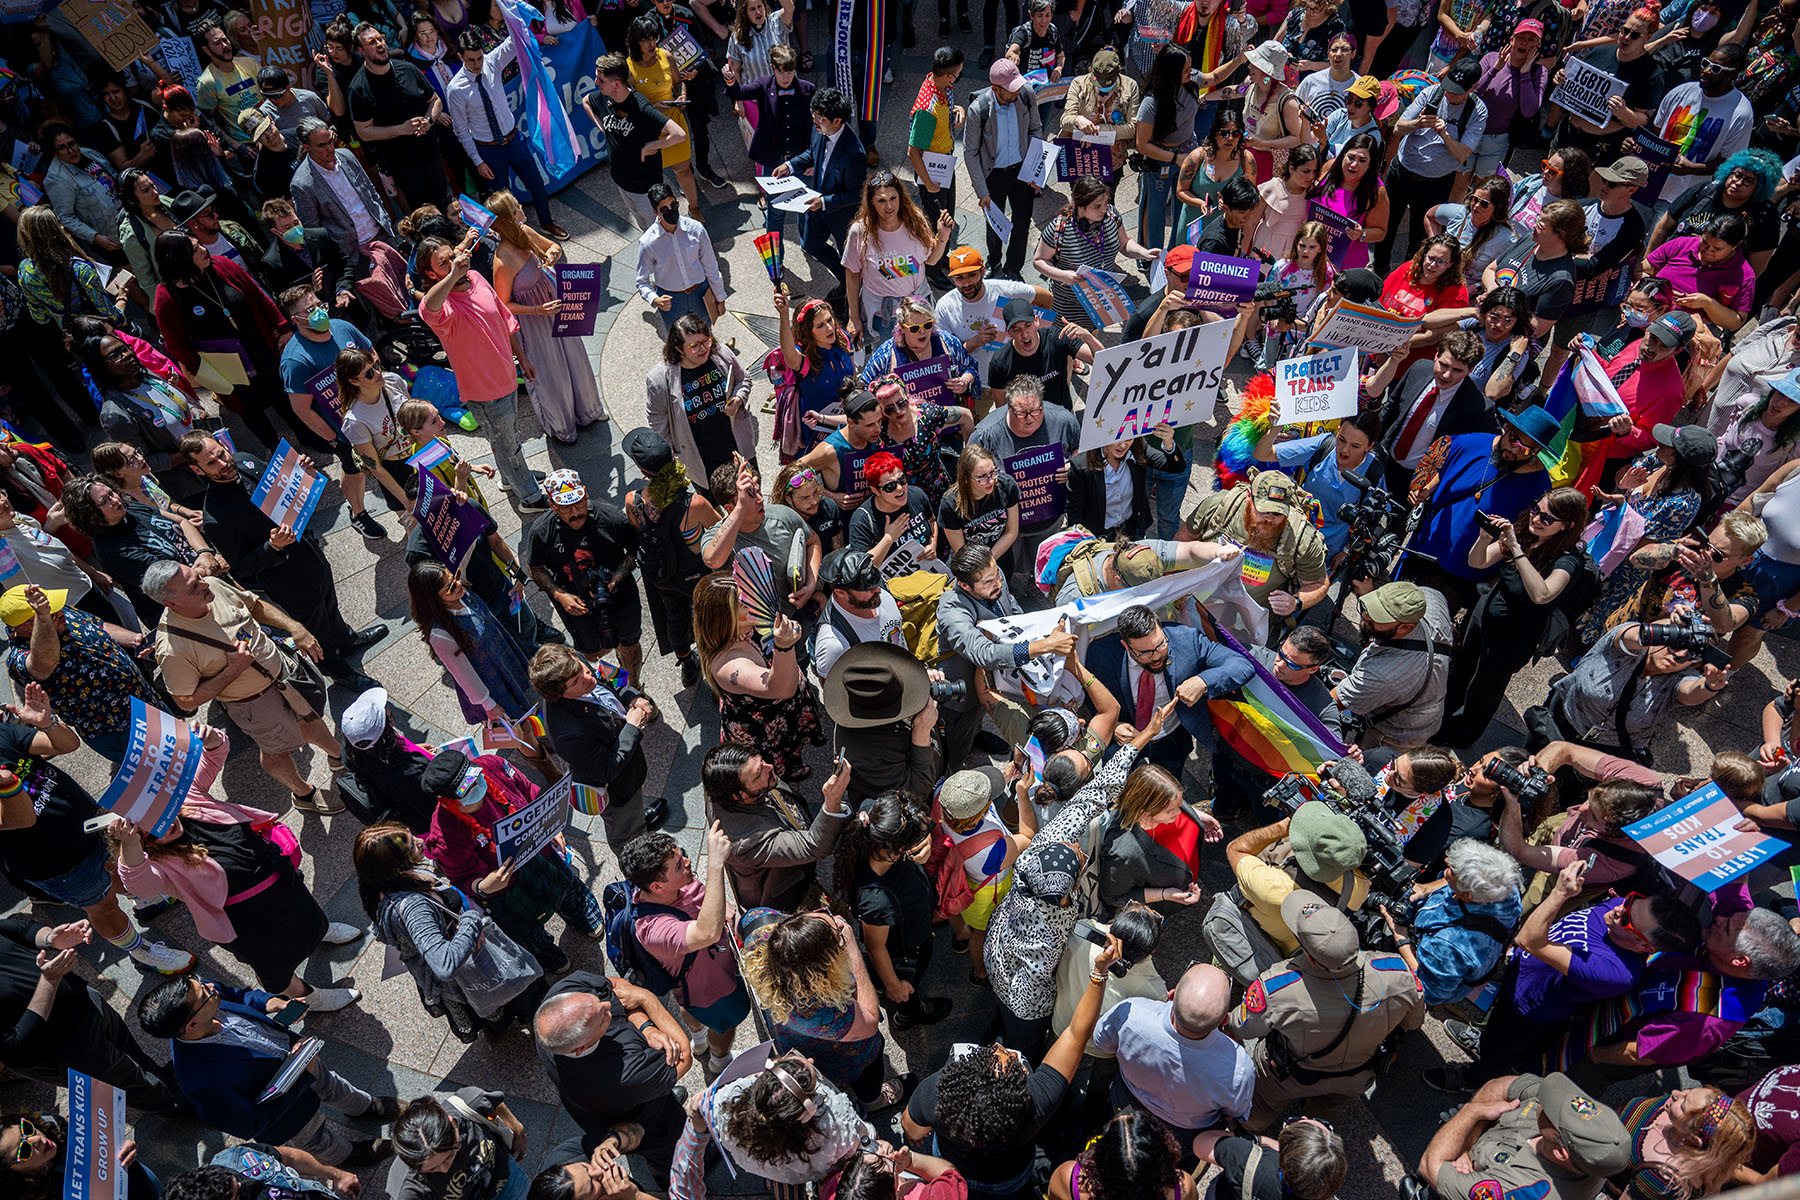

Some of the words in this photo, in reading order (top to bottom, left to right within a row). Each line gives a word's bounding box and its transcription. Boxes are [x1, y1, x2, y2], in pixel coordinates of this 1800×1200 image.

[80, 1, 131, 36] TRANS
[98, 18, 156, 66] KIDS!!
[677, 30, 687, 41] BE
[838, 1, 852, 64] REJOICE
[161, 41, 176, 60] YOU
[267, 44, 306, 66] ARE
[1574, 66, 1612, 94] LGBTQ
[602, 114, 635, 136] Unity
[1638, 134, 1672, 157] ORGANIZE
[937, 163, 948, 171] 404
[1061, 144, 1069, 177] ORGANIZE
[1069, 166, 1076, 177] TO
[1314, 212, 1324, 221] TO
[1315, 207, 1349, 226] ORGANIZE
[876, 254, 914, 270] PRIDE
[1201, 260, 1250, 279] ORGANIZE
[561, 270, 595, 279] ORGANIZE
[562, 281, 572, 290] TO
[1199, 274, 1211, 287] TO
[563, 292, 592, 301] PROTECT
[1082, 287, 1101, 312] KIDS
[1101, 288, 1116, 301] TO
[1105, 277, 1132, 308] LISTEN
[1194, 288, 1239, 303] PROTECT
[561, 303, 584, 311] TRANS
[1336, 315, 1361, 327] TRANS
[1362, 321, 1380, 330] KIDS
[903, 363, 943, 382] ORGANIZE
[1284, 355, 1342, 380] PROTECT
[321, 388, 335, 400] TO
[681, 369, 723, 396] PROTECT
[906, 382, 917, 393] TO
[912, 386, 943, 402] ROTECT
[1122, 366, 1222, 404] means
[1288, 376, 1335, 396] TRANS
[684, 381, 727, 412] TRANS
[1295, 394, 1331, 415] KIDS.
[1115, 399, 1178, 440] ALL
[1012, 451, 1055, 471] ORGANIZE
[261, 453, 285, 494] LISTEN
[277, 474, 290, 490] TO
[1014, 470, 1026, 480] TO
[1017, 474, 1054, 489] PROTECT
[281, 472, 302, 510] TRANS
[292, 485, 310, 514] KIDS
[420, 473, 434, 518] ORGANIZE
[1019, 494, 1053, 509] TEXANS
[1020, 486, 1047, 500] TRANS
[426, 512, 436, 527] TO
[432, 495, 451, 536] PROTECT
[437, 513, 451, 544] TRANS
[441, 517, 461, 553] TEXANS
[895, 524, 926, 547] TRANS
[120, 718, 147, 784] LISTEN
[143, 744, 159, 769] TO
[147, 733, 176, 796] TRANS
[164, 749, 188, 796] KIDS
[501, 782, 569, 837] TOGETHER
[514, 819, 541, 847] COME
[541, 804, 561, 825] HELL
[532, 826, 544, 841] OR
[535, 819, 562, 846] WATER
[1662, 814, 1704, 840] KIDS
[1673, 826, 1726, 855] TRANS
[1705, 845, 1733, 861] TO
[1708, 846, 1768, 880] LISTEN
[1562, 907, 1594, 952] ROTEC
[465, 980, 492, 993] NEW
[75, 1074, 86, 1113] KIDS
[98, 1107, 108, 1129] UP
[73, 1113, 86, 1166] TRANS
[97, 1129, 108, 1182] GROW
[71, 1168, 83, 1200] LET
